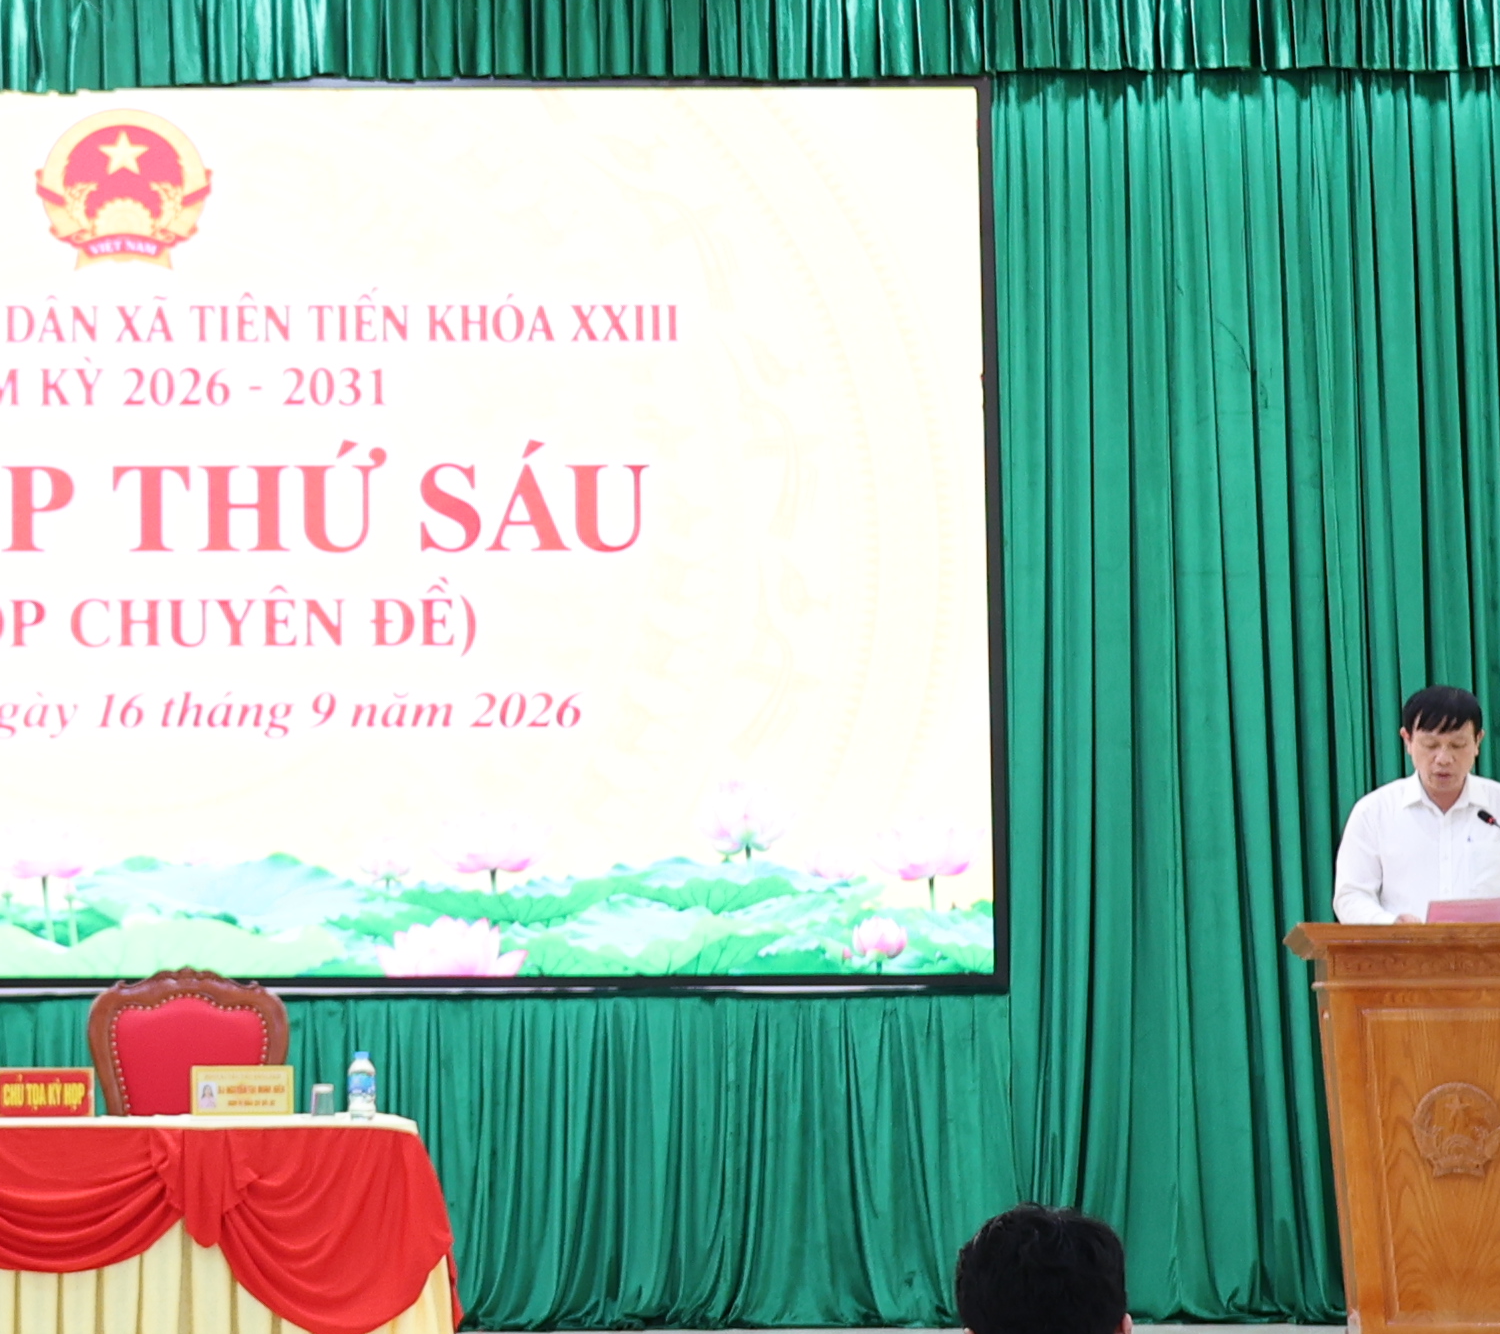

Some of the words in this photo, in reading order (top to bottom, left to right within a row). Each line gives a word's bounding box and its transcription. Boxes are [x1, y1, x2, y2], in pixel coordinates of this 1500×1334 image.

[7, 295, 97, 343] DÂN
[116, 296, 174, 343] XÃ
[190, 292, 290, 343] TIÊN
[309, 288, 408, 343] TIẾN
[428, 294, 555, 343] KHÓA
[572, 304, 678, 343] XXIII
[42, 357, 102, 406] KỲ
[124, 367, 231, 407] 2026
[284, 367, 384, 407] 2031
[113, 439, 387, 554] THỨ
[420, 439, 649, 554] SÁU
[70, 585, 344, 649] CHUYÊN
[371, 576, 477, 656] ĐỀ)
[98, 694, 144, 728] 16
[161, 689, 293, 739] tháng
[312, 693, 337, 727] 9
[351, 693, 453, 728] năm
[471, 692, 581, 728] 2026
